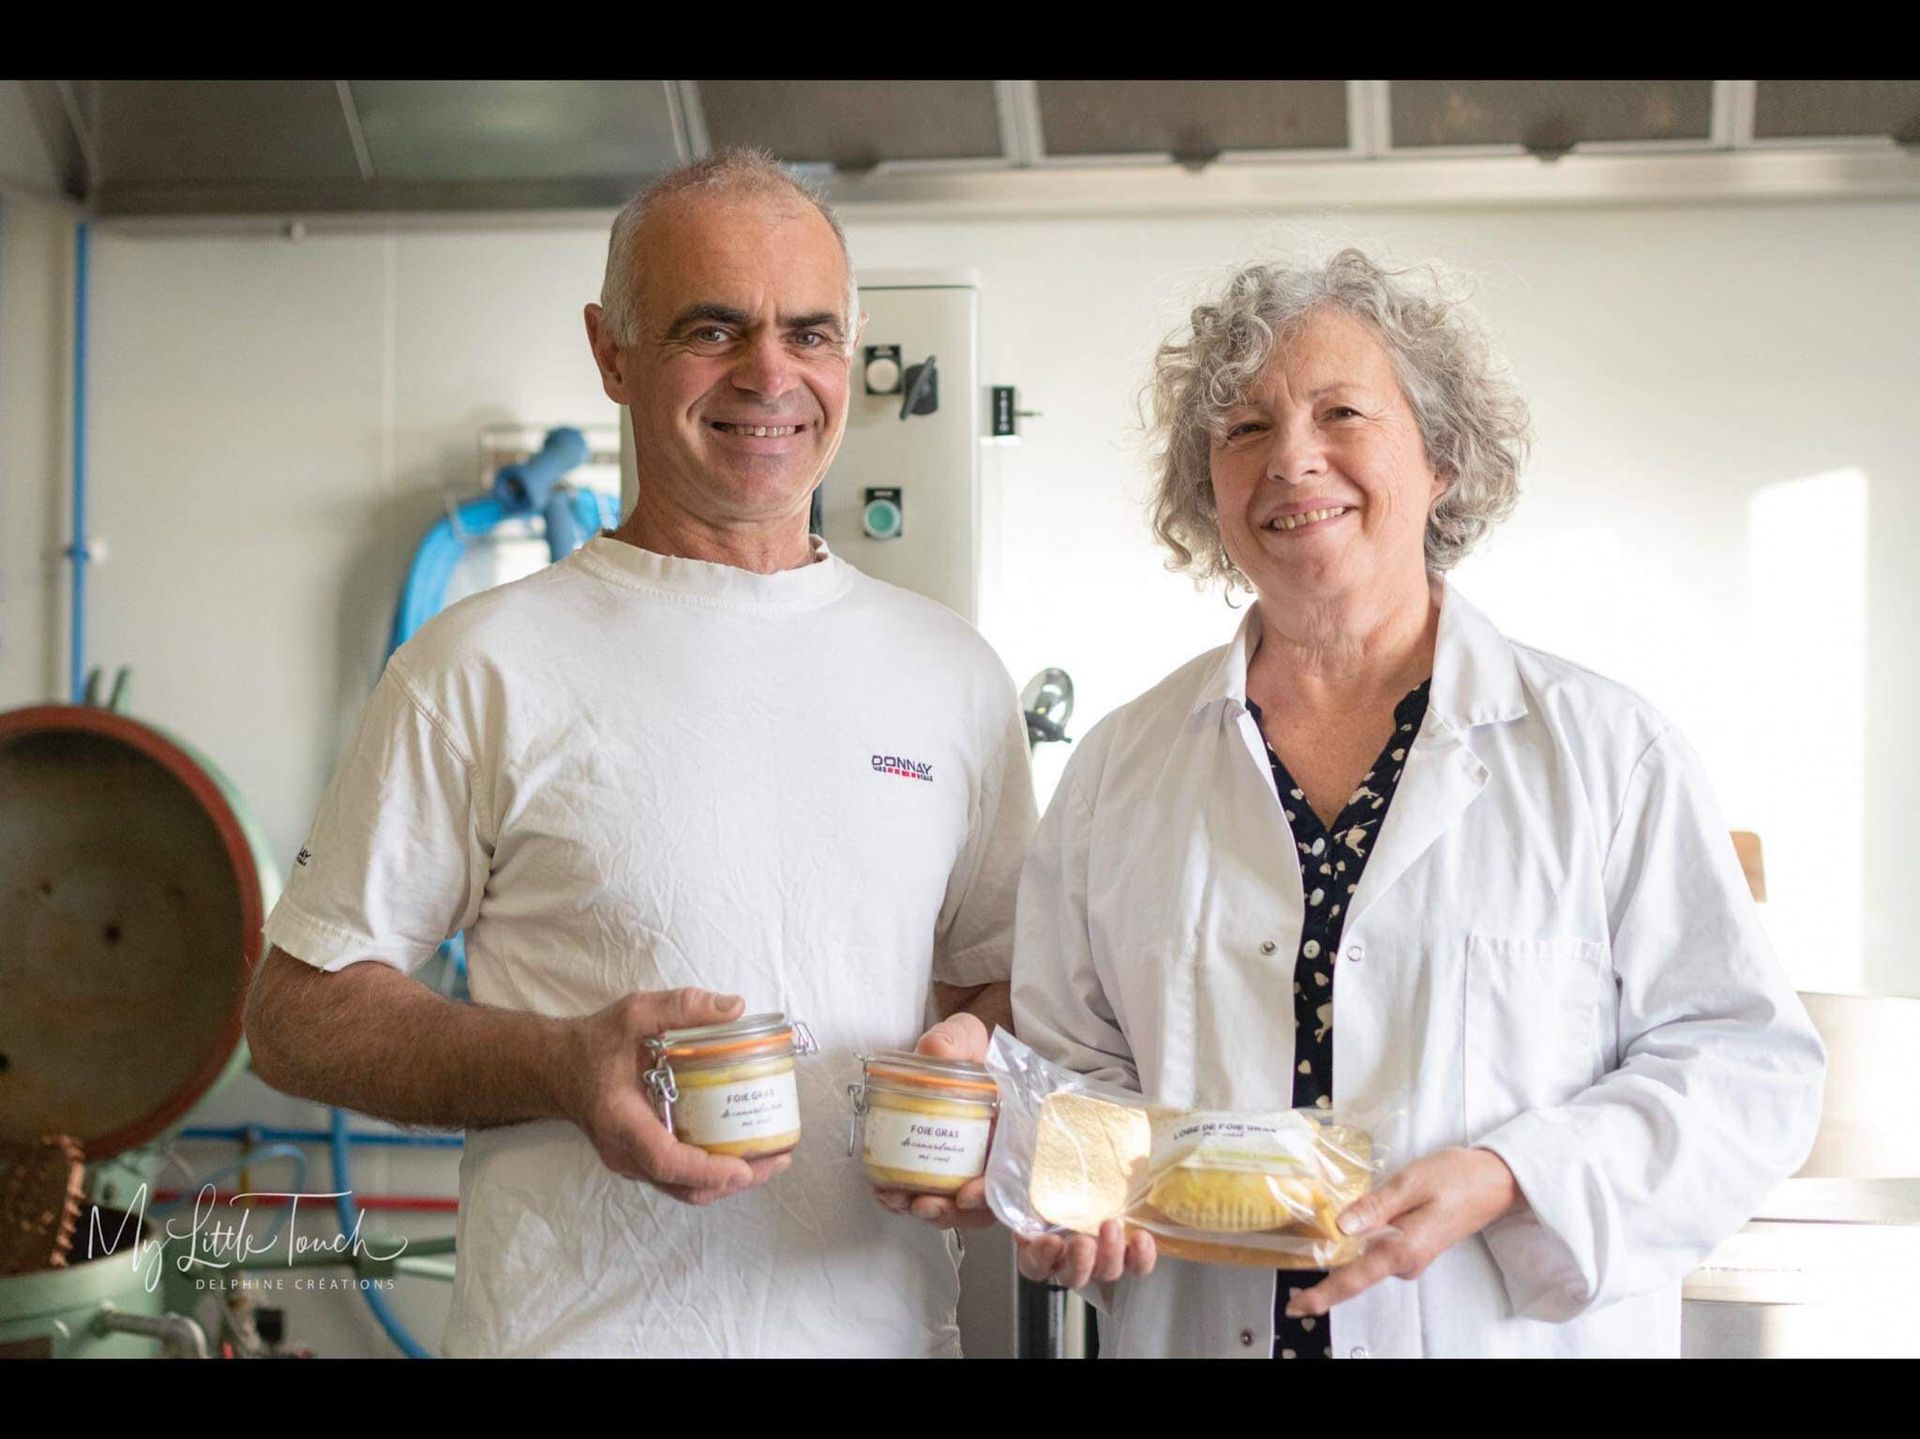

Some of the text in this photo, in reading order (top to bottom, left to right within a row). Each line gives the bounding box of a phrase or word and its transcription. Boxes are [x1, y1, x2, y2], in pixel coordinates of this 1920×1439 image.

[871, 755, 932, 775] DONNAY
[727, 1094, 750, 1104] FOIE
[911, 1125, 959, 1138] FOIE GRAS
[1202, 1123, 1216, 1131] DE
[1218, 1123, 1244, 1131] FOIE
